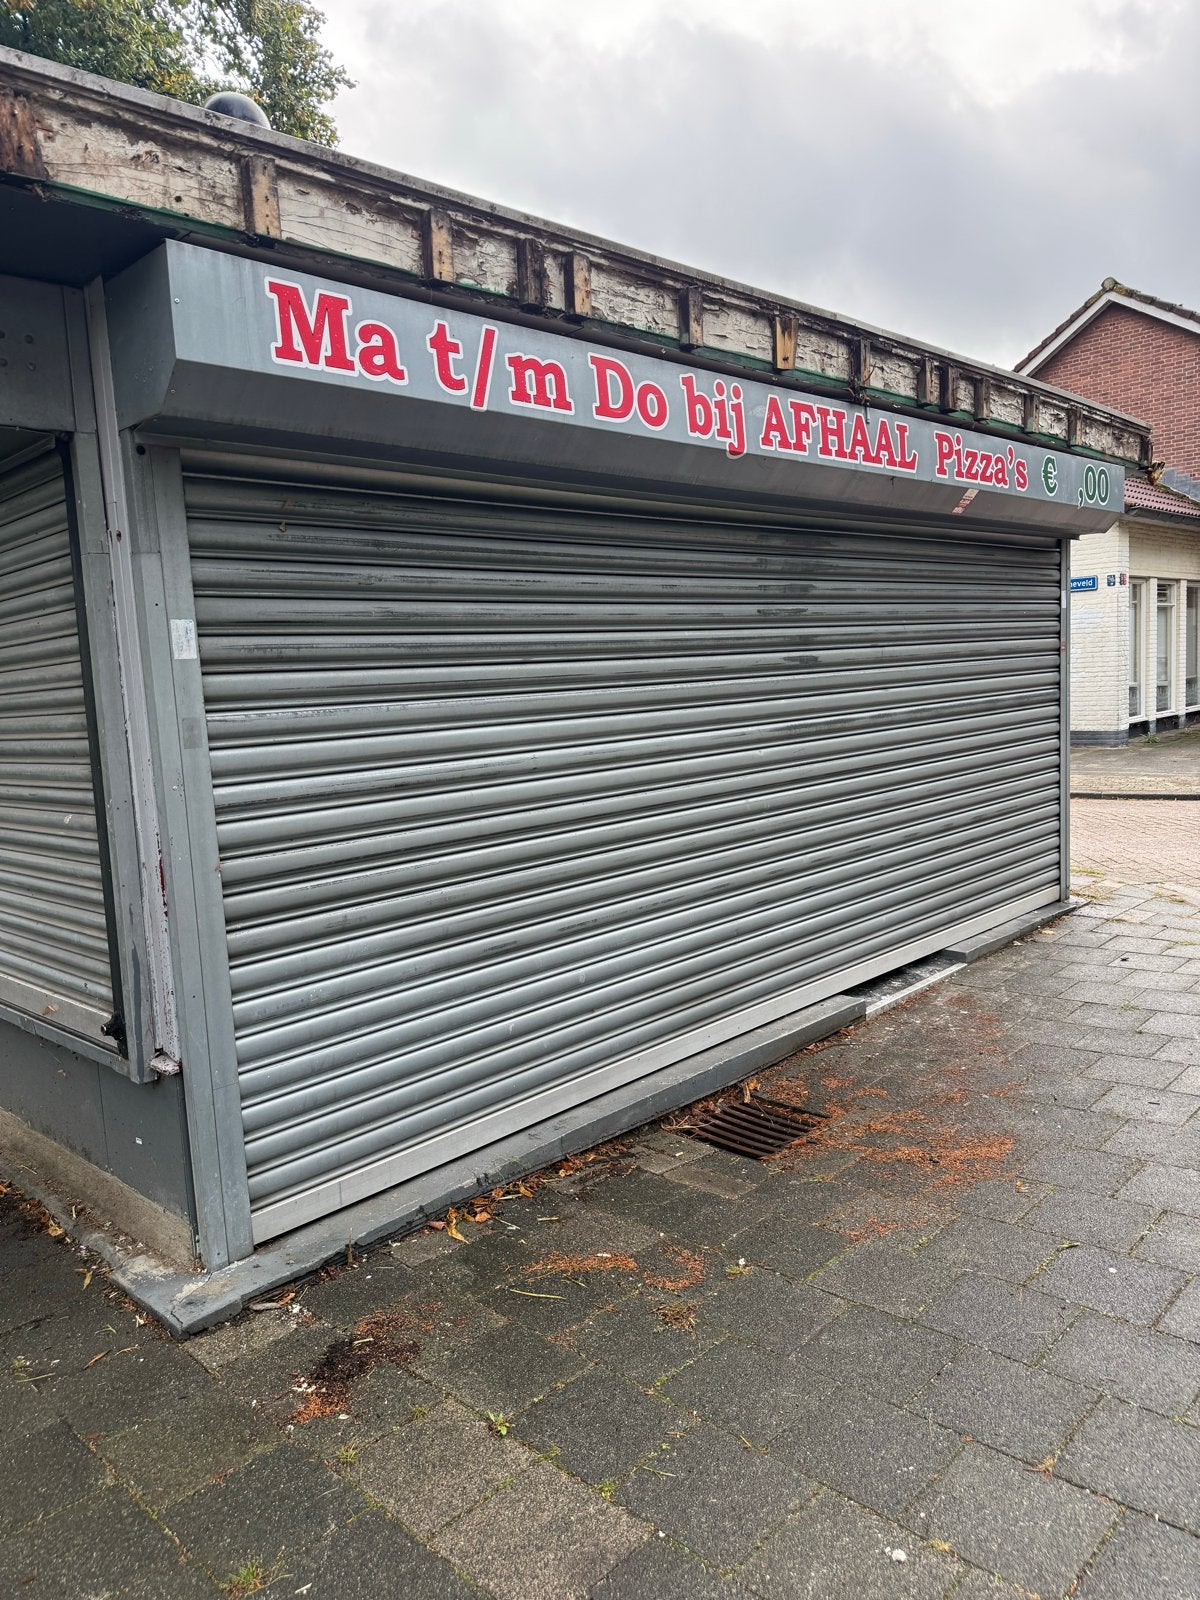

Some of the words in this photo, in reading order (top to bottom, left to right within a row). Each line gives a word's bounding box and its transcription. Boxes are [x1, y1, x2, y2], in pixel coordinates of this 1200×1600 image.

[267, 279, 406, 382] Ma
[427, 322, 573, 412] t/m
[589, 355, 668, 428] Do
[680, 375, 746, 456] bij
[760, 396, 918, 471] AFHAAL
[935, 431, 1028, 490] Pizza's
[1042, 456, 1058, 495] €
[1079, 465, 1109, 507] ,00
